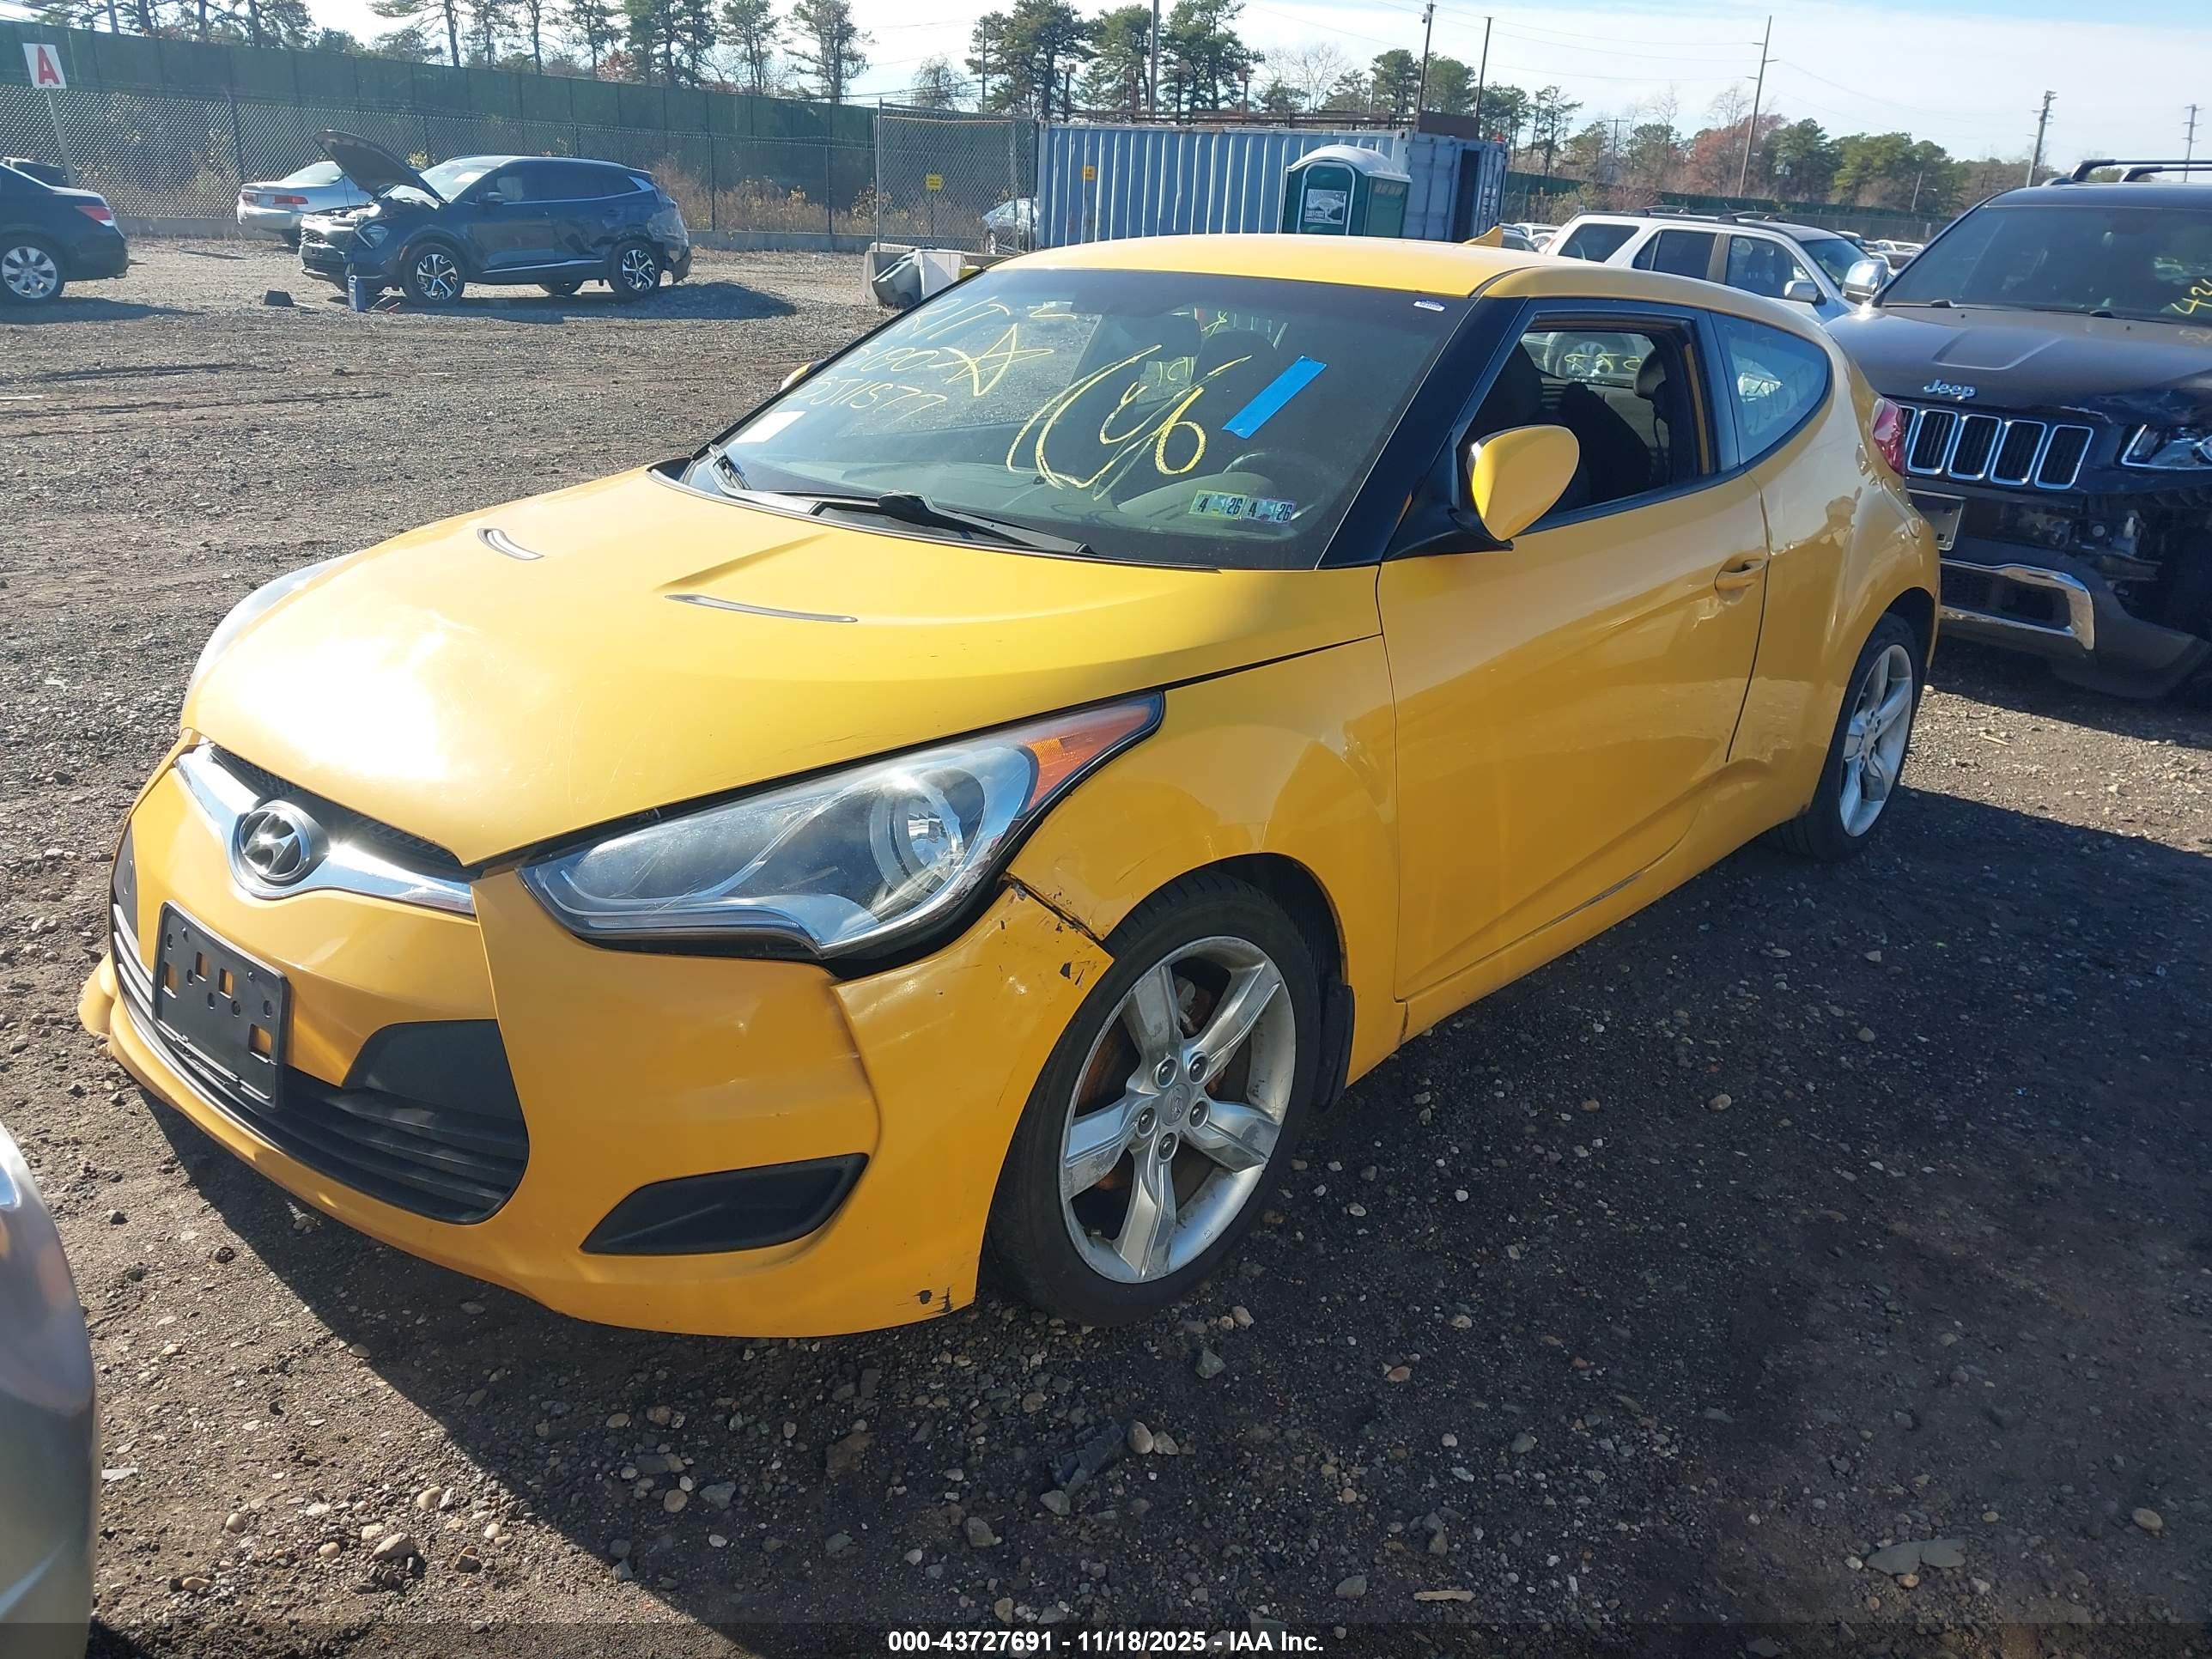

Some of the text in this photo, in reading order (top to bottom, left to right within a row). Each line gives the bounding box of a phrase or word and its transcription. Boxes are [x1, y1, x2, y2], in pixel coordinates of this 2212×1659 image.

[38, 46, 60, 84] A
[1923, 379, 1976, 401] Jeep
[1198, 498, 1243, 515] 4 26
[1249, 502, 1293, 521] 4 26
